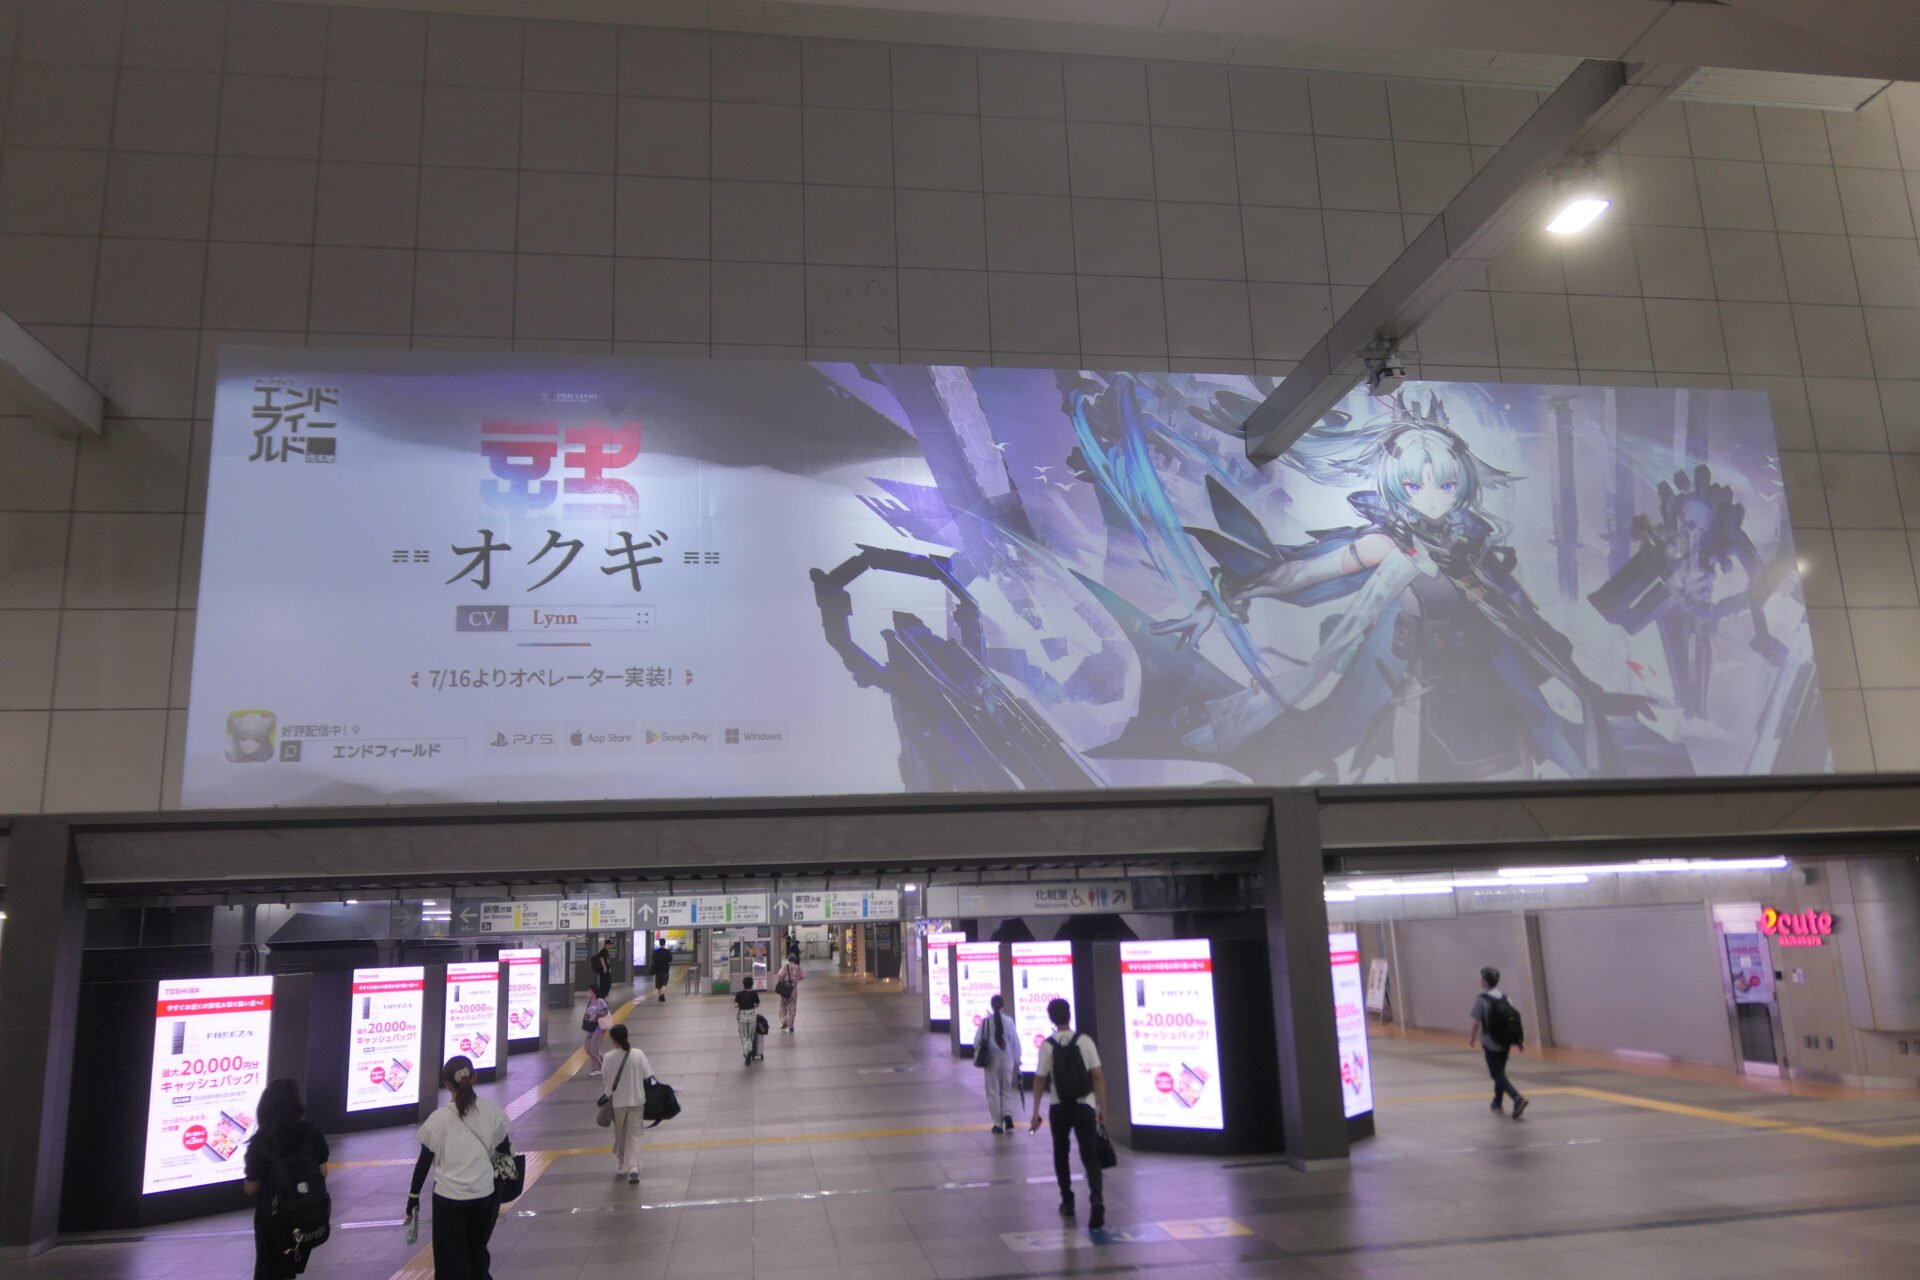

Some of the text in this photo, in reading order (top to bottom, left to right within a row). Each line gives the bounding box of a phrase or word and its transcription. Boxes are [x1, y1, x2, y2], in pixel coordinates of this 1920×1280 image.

[252, 386, 339, 413] エンド
[251, 413, 337, 437] フィー
[248, 436, 305, 462] ルド
[445, 529, 668, 592] オクギ
[467, 610, 578, 628] CV Lynn
[429, 666, 672, 691] 7/16よりオペレーター実装!
[281, 724, 348, 738] 好評配信中!
[661, 731, 708, 743] Google Play
[744, 732, 783, 741] Windows
[513, 733, 553, 745] PS5
[587, 733, 632, 744] App Store
[332, 743, 440, 759] エンドフィールド
[733, 896, 738, 904] 2
[831, 893, 837, 902] 3
[868, 892, 874, 900] 4
[1036, 888, 1068, 901] 化粧室
[523, 903, 529, 912] 5
[660, 899, 688, 909] 上野方面
[1760, 907, 1832, 935] ecute
[165, 987, 200, 995] TOSHIBA
[206, 1030, 254, 1040] FREEZA
[161, 1055, 259, 1078] 最大20,000円分
[160, 1072, 259, 1092] キャッシュバック!
